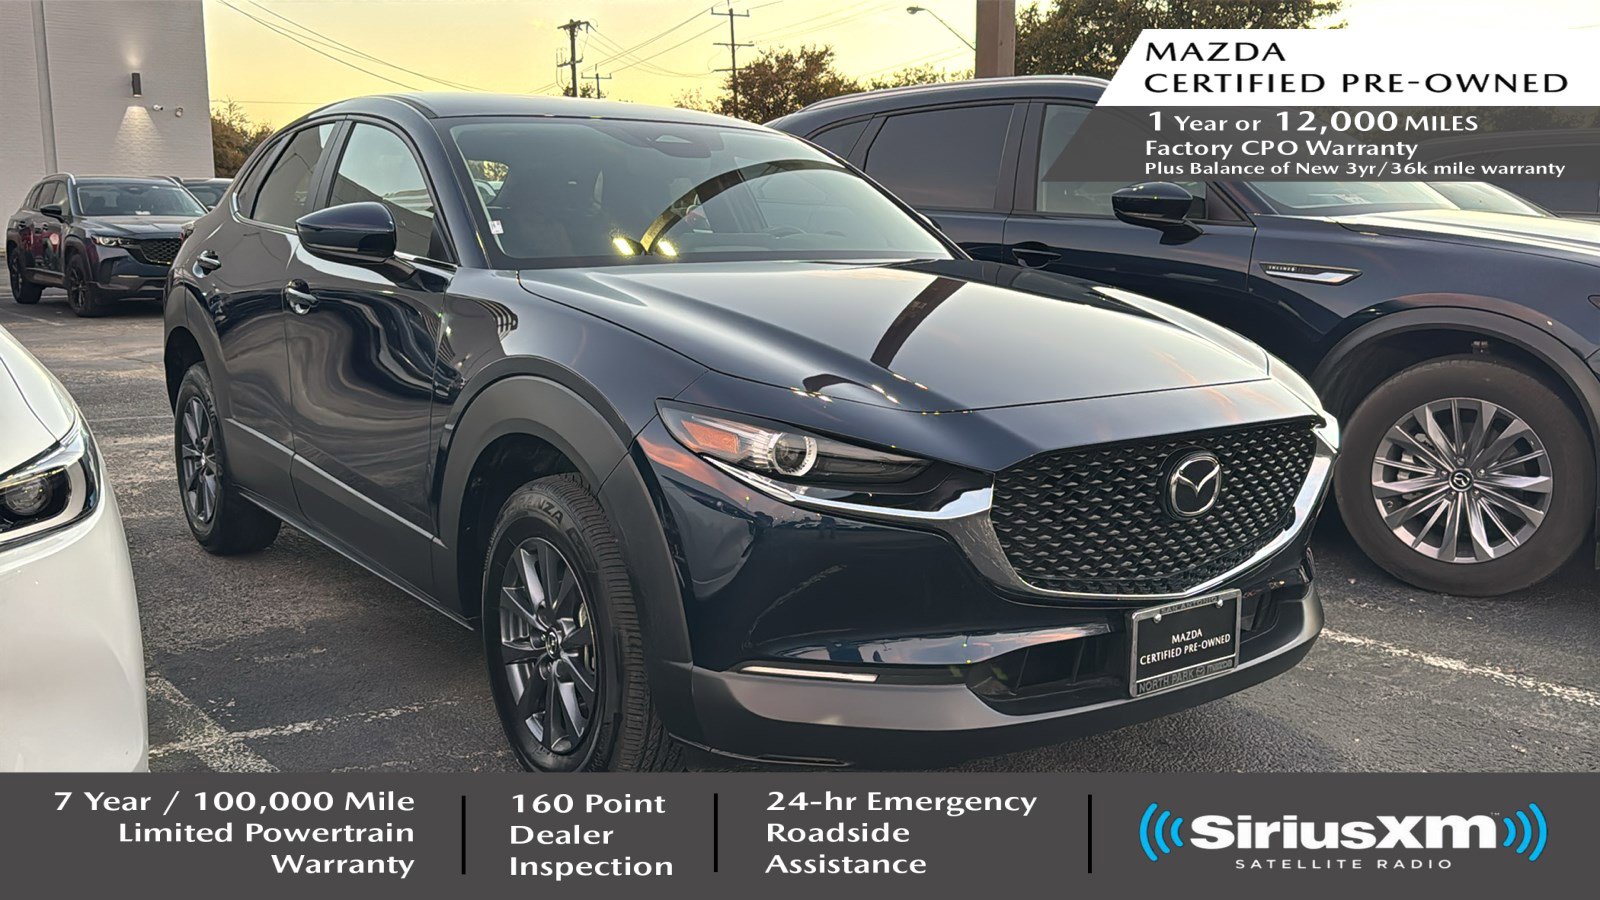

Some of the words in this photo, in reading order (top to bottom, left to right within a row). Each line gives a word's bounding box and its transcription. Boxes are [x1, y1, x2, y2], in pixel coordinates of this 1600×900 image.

[1171, 628, 1203, 644] MAZDA
[1139, 647, 1182, 665] CERTIFIED
[1183, 633, 1231, 654] PRE-OWNED
[1139, 676, 1170, 693] NORTH
[1171, 670, 1194, 685] PARK
